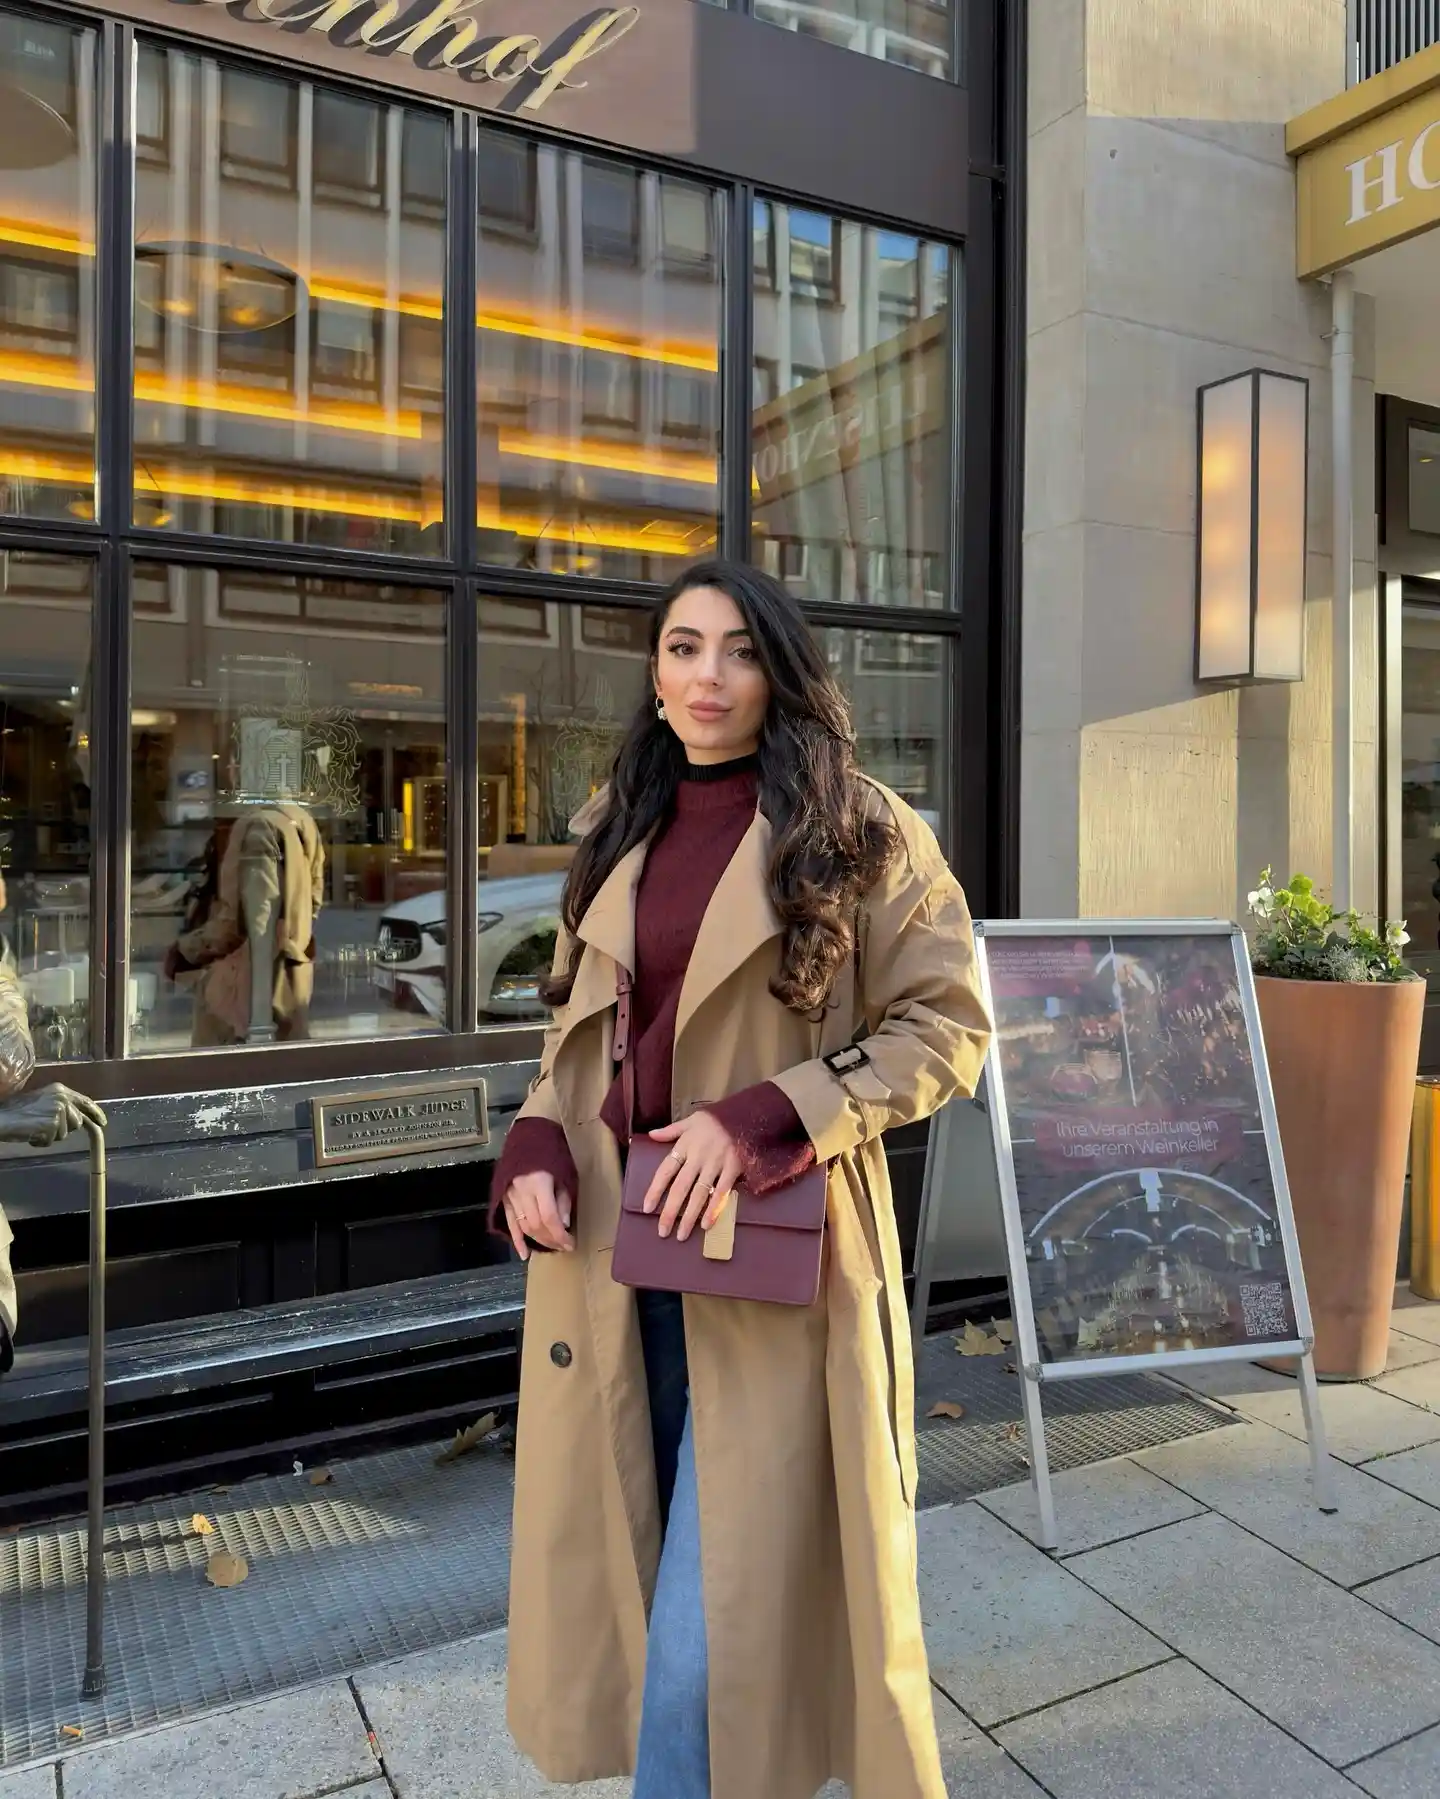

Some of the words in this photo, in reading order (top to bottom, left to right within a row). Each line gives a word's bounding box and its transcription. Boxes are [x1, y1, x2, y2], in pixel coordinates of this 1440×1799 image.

[335, 1104, 417, 1126] SIDEWALK
[421, 1099, 467, 1116] JUDGE
[1056, 1121, 1088, 1138] Ihre
[1090, 1117, 1202, 1137] Veranstaltung
[1203, 1116, 1219, 1132] in
[1062, 1141, 1135, 1158] unserem
[1136, 1137, 1219, 1155] Weinkeller
